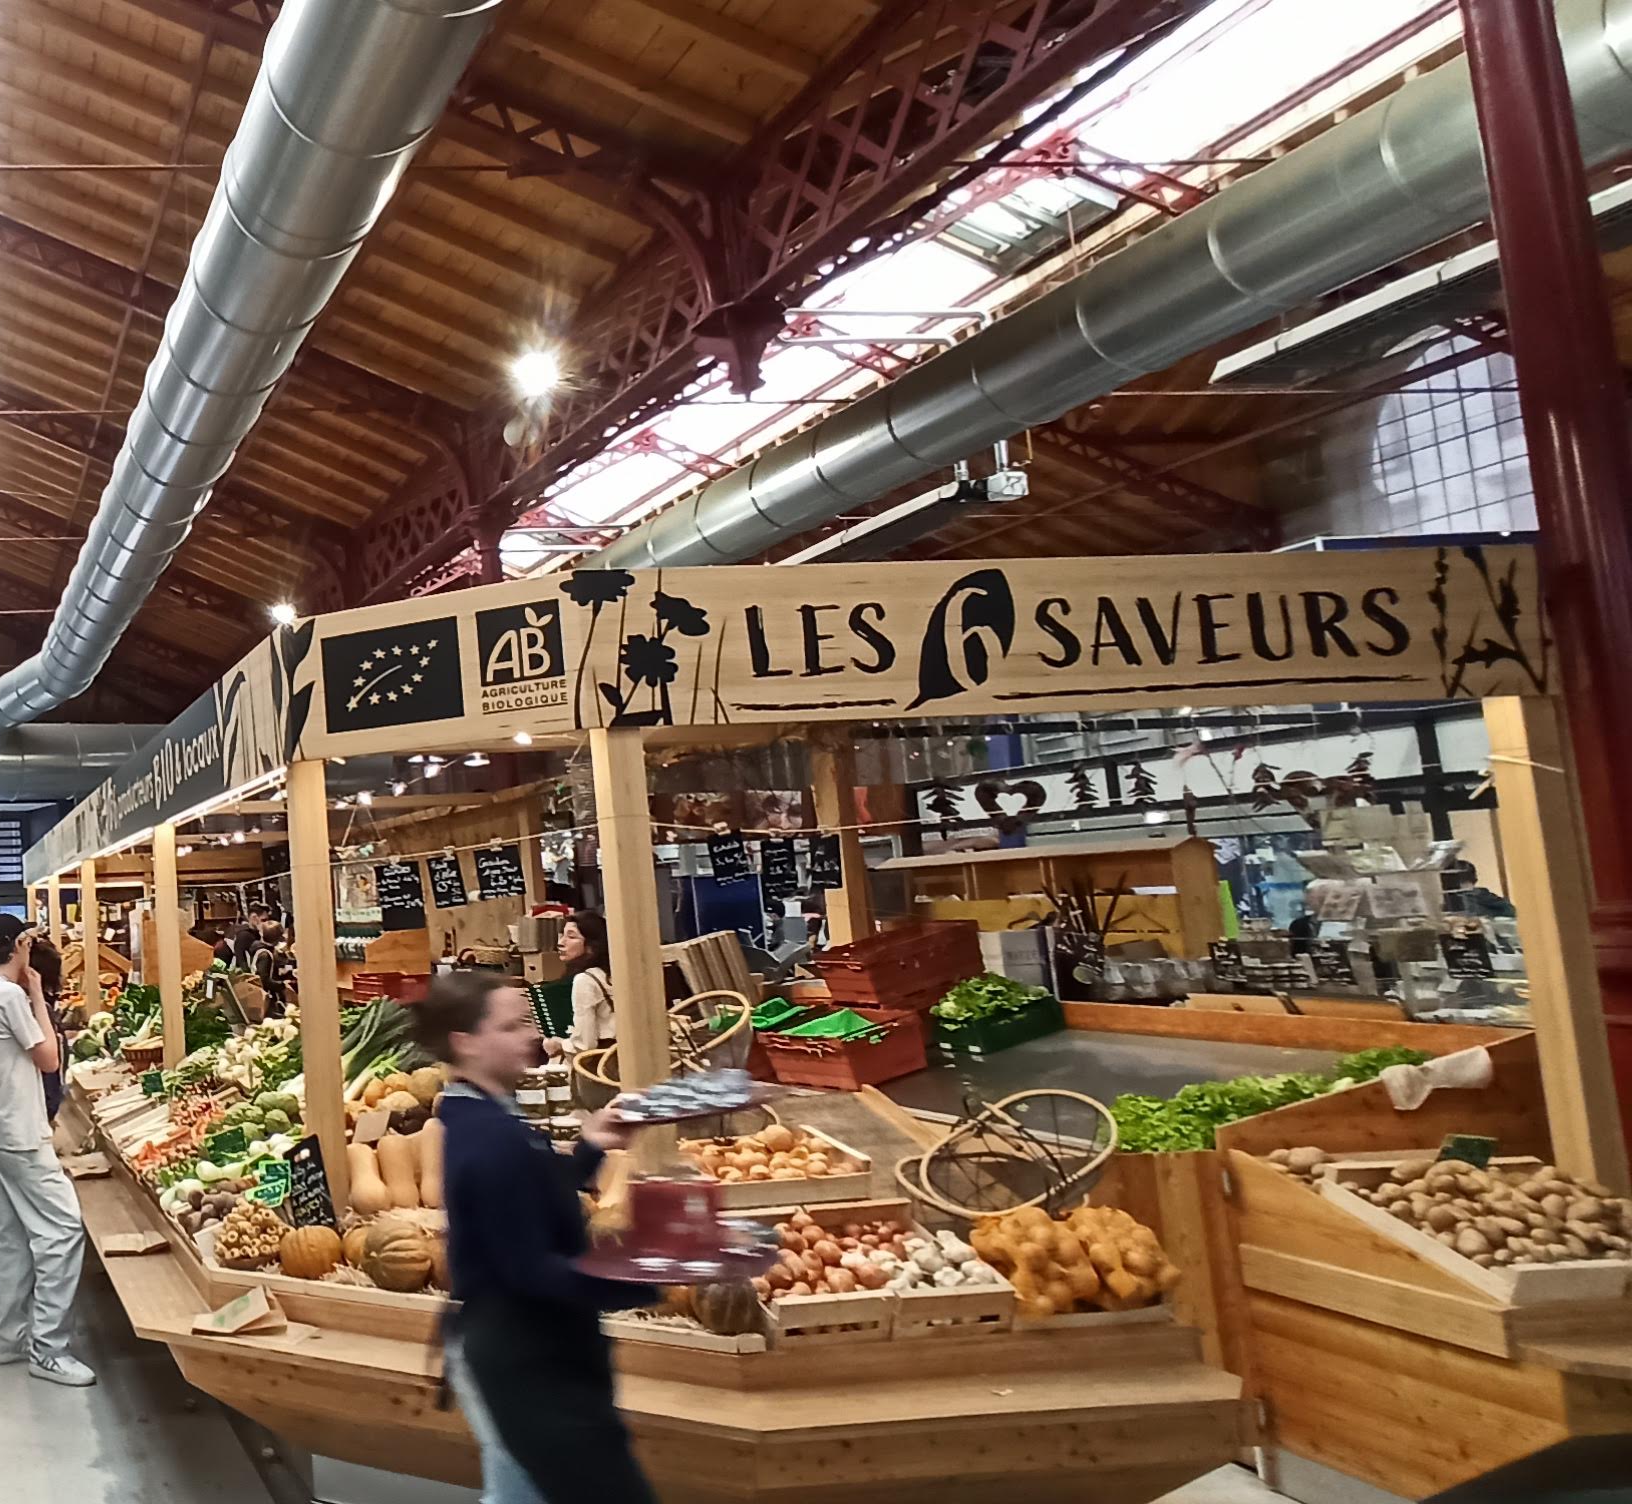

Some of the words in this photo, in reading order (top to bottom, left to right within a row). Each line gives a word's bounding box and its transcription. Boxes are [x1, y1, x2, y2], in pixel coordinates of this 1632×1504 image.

[485, 626, 552, 682] AB
[744, 602, 897, 678] LES
[1034, 586, 1411, 669] SAVEURS
[481, 678, 568, 699] AGRICULTURE
[482, 692, 569, 712] BIOLOGIQUE
[182, 723, 220, 781] locaux
